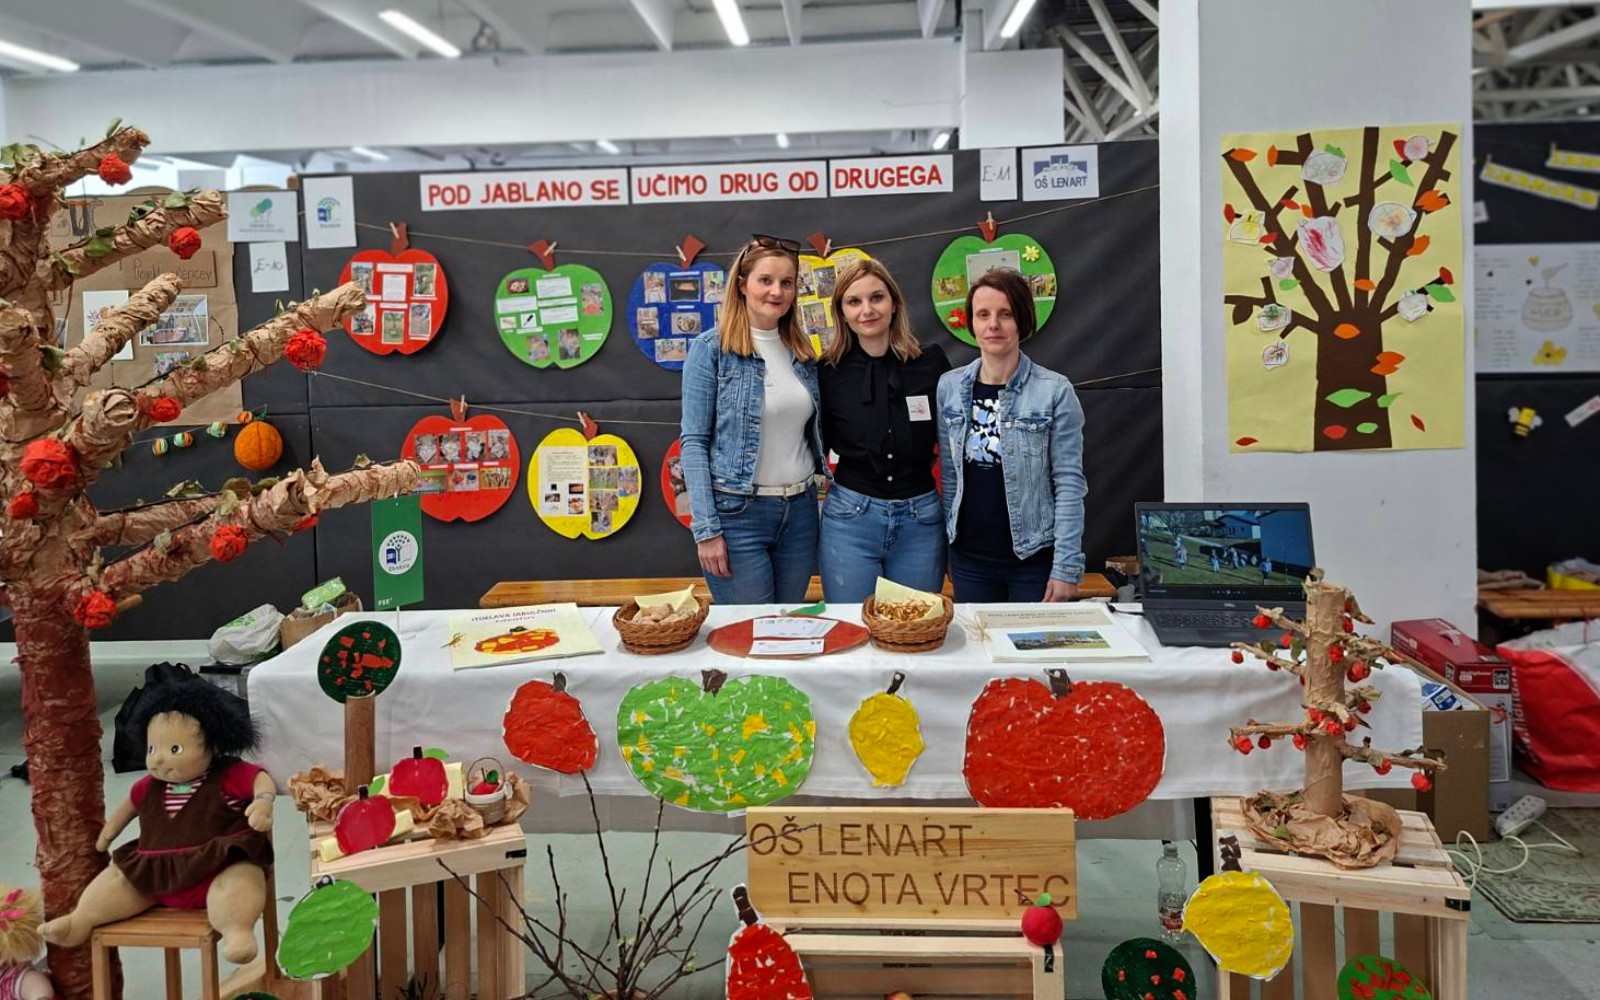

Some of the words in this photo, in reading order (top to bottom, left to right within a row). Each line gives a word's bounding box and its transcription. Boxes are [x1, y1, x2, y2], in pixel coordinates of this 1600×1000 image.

[637, 172, 708, 197] UČIMO
[720, 172, 779, 195] DRUG
[788, 171, 819, 192] OD
[834, 163, 943, 189] DRUGEGA
[1034, 175, 1048, 189] OŠ
[1051, 176, 1087, 189] LENART
[429, 183, 471, 206] POD
[480, 181, 583, 204] JABLANO
[590, 179, 620, 201] SE
[750, 815, 804, 856] OŠ
[817, 823, 973, 857] LENART
[788, 871, 923, 905] ENOTA
[933, 872, 1070, 907] VRTEC
